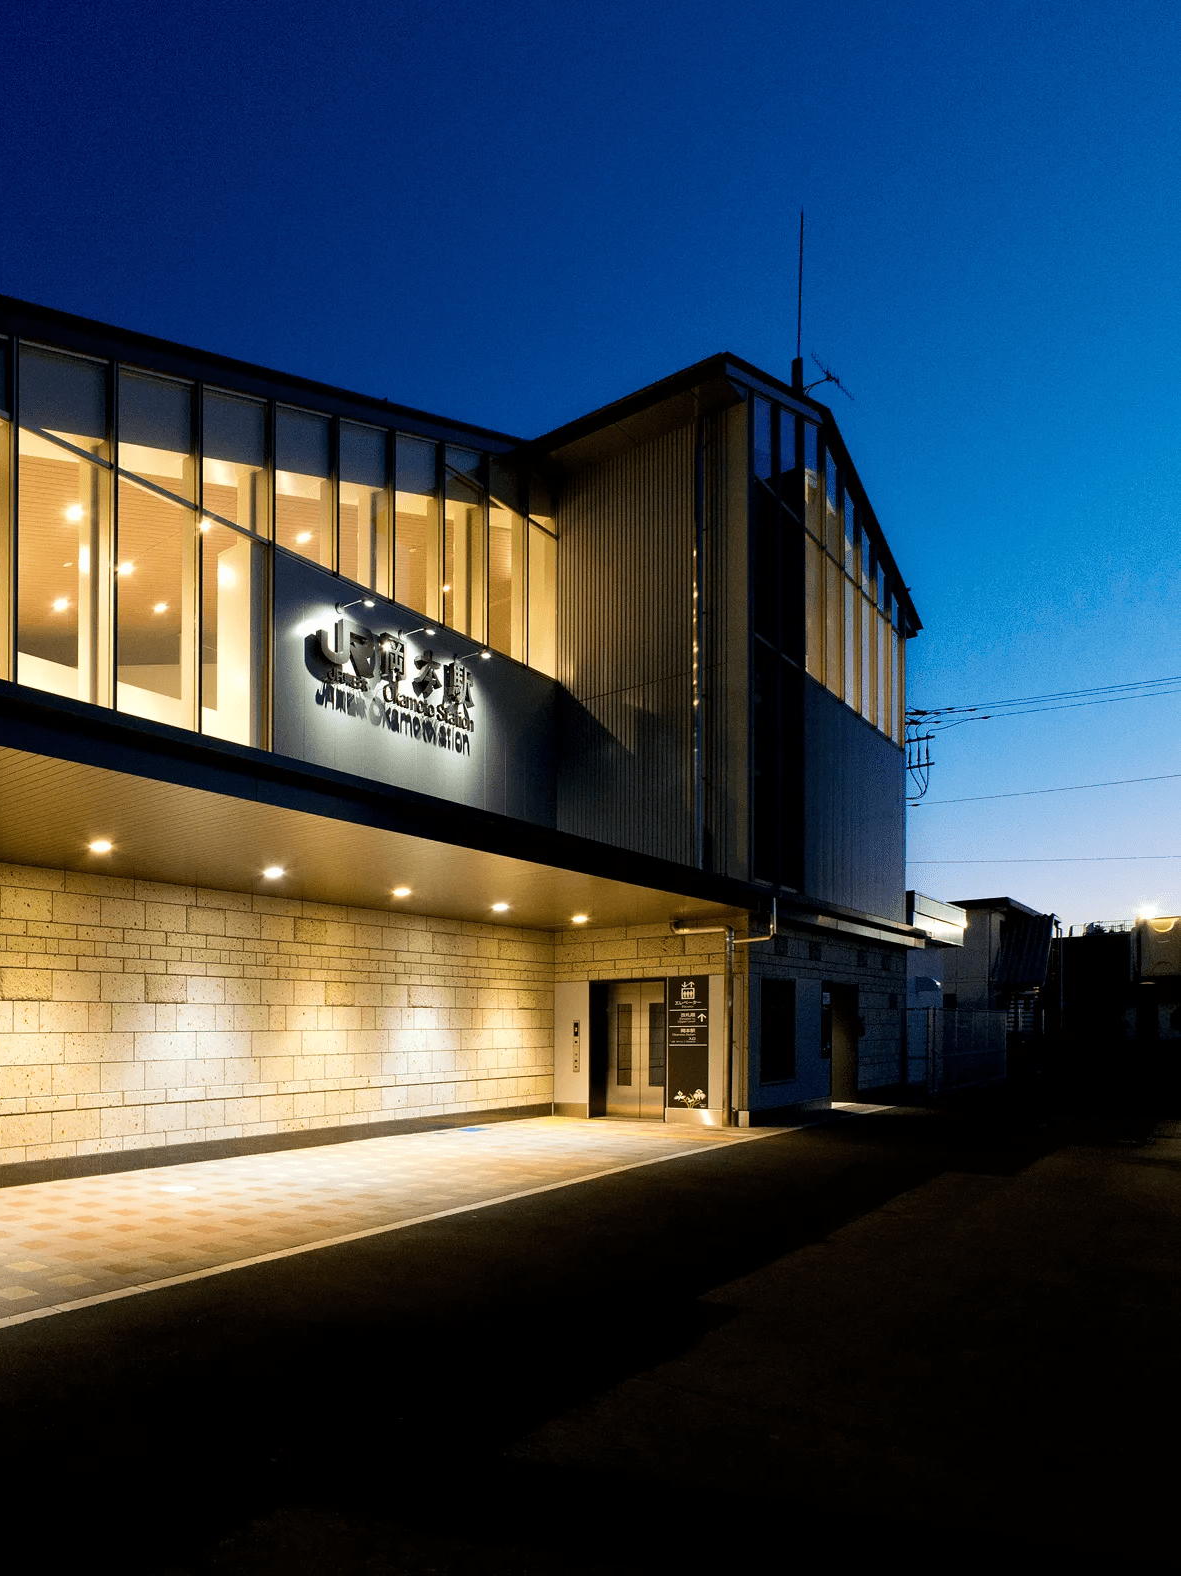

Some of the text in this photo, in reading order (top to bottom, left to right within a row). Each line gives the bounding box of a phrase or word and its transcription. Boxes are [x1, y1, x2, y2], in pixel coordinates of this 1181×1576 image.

[316, 619, 376, 678] JR
[383, 683, 474, 732] Okamoto Station
